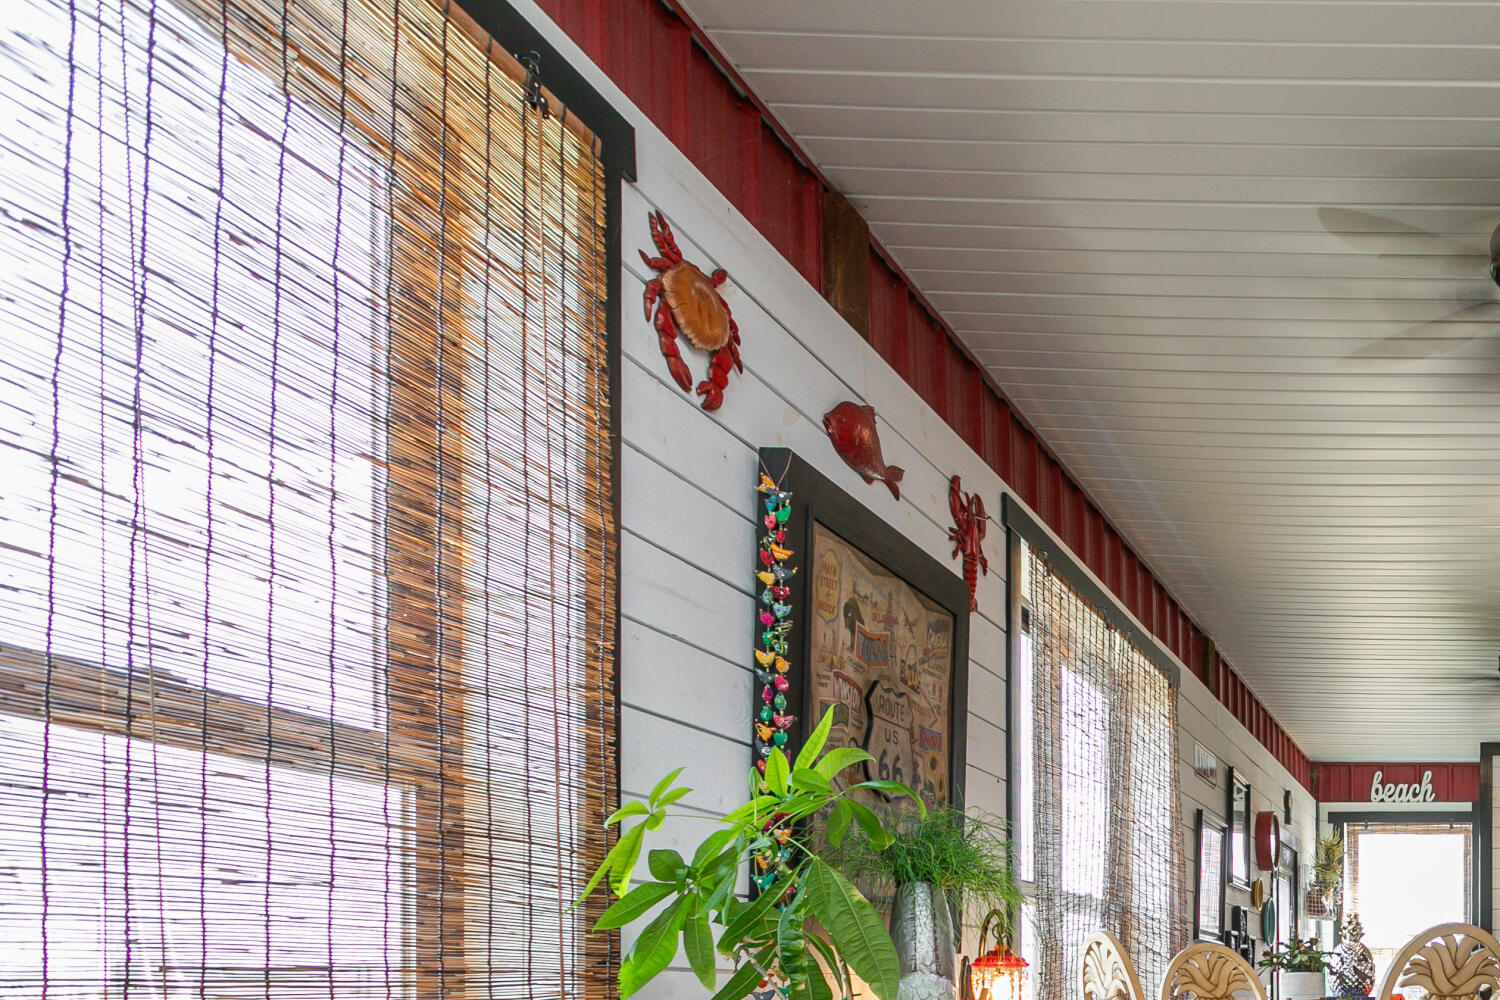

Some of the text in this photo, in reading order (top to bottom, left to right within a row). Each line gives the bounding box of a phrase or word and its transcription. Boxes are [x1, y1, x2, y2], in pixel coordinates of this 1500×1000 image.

[857, 630, 889, 664] TULSA
[879, 694, 905, 722] ROUTE
[884, 727, 899, 745] US
[878, 748, 904, 782] 66
[1370, 770, 1436, 803] beach
